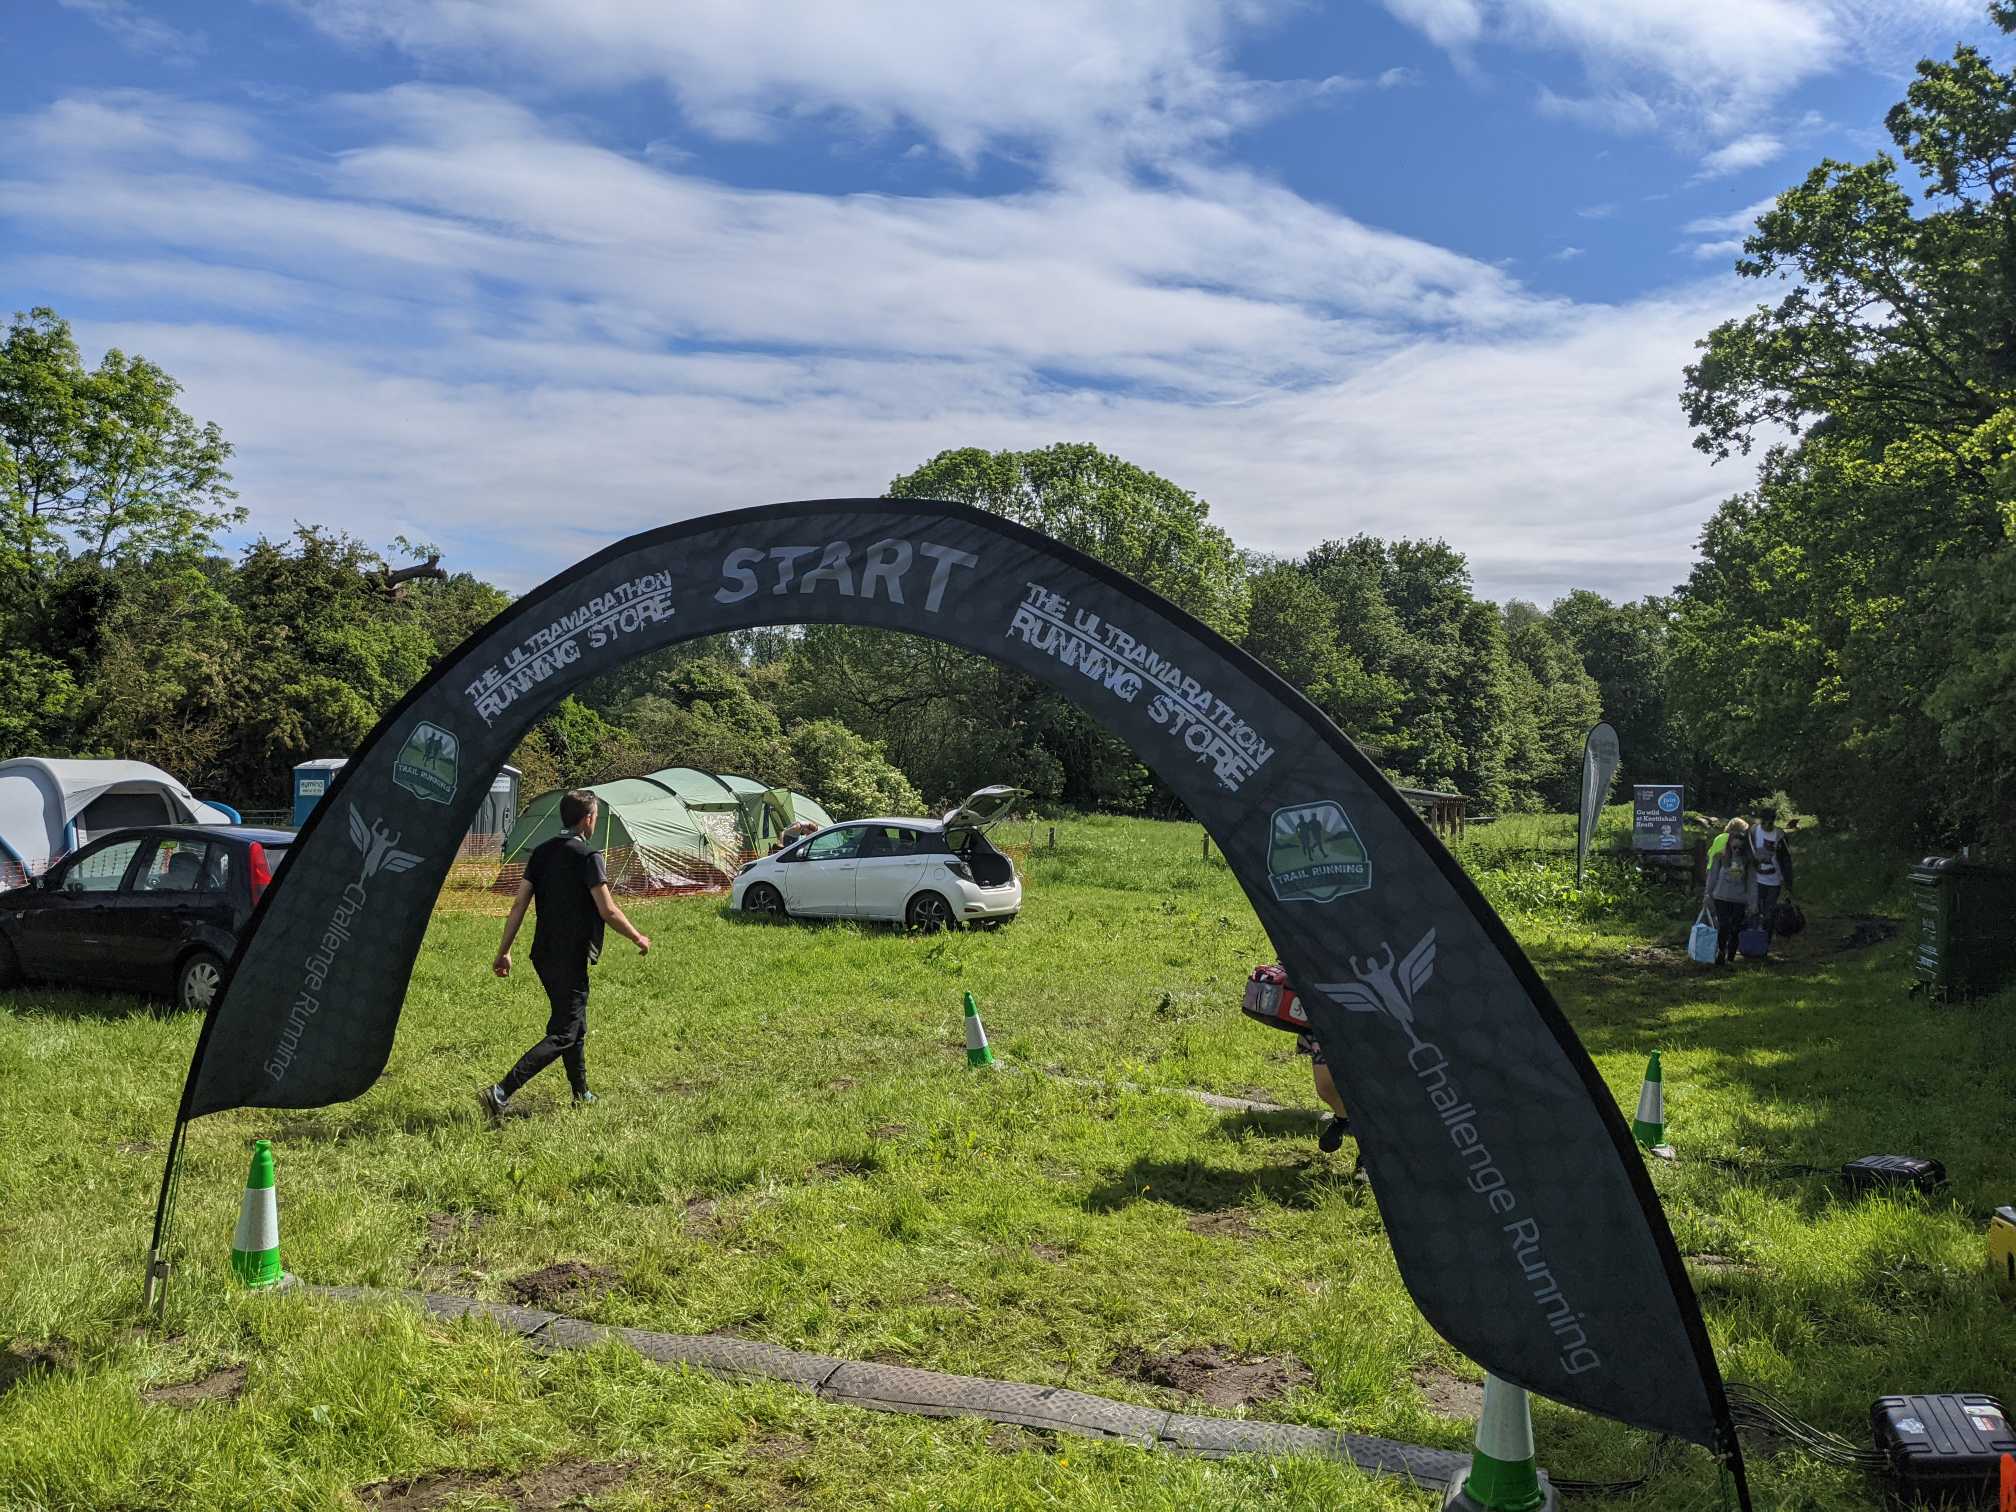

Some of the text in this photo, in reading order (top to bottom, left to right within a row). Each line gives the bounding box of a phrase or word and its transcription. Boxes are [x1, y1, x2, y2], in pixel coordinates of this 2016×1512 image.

[465, 569, 672, 699] THE ULTRAMARATHON
[713, 537, 978, 613] START
[476, 592, 675, 728] RUNNING STORE
[1005, 611, 1255, 792] RUNNING STORE
[1027, 582, 1275, 763] THE ULTRAMARATHON
[1276, 864, 1364, 884] TRAIL RUNNING
[264, 882, 367, 1082] Challenge Running
[1407, 1042, 1600, 1375] Challenge Running
